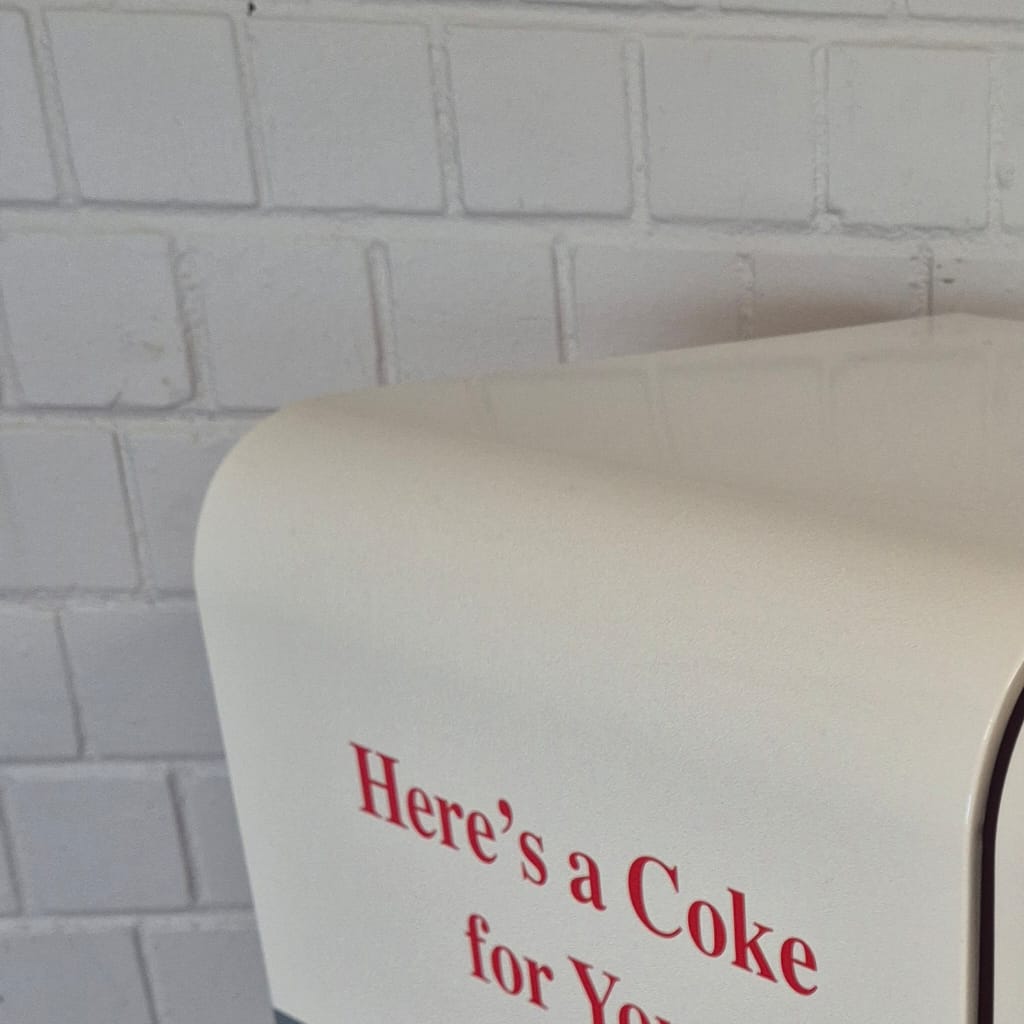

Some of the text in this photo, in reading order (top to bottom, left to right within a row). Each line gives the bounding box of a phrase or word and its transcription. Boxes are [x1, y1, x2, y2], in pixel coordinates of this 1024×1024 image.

[464, 913, 555, 1010] for
[569, 852, 606, 911] a
[627, 856, 819, 997] Coke
